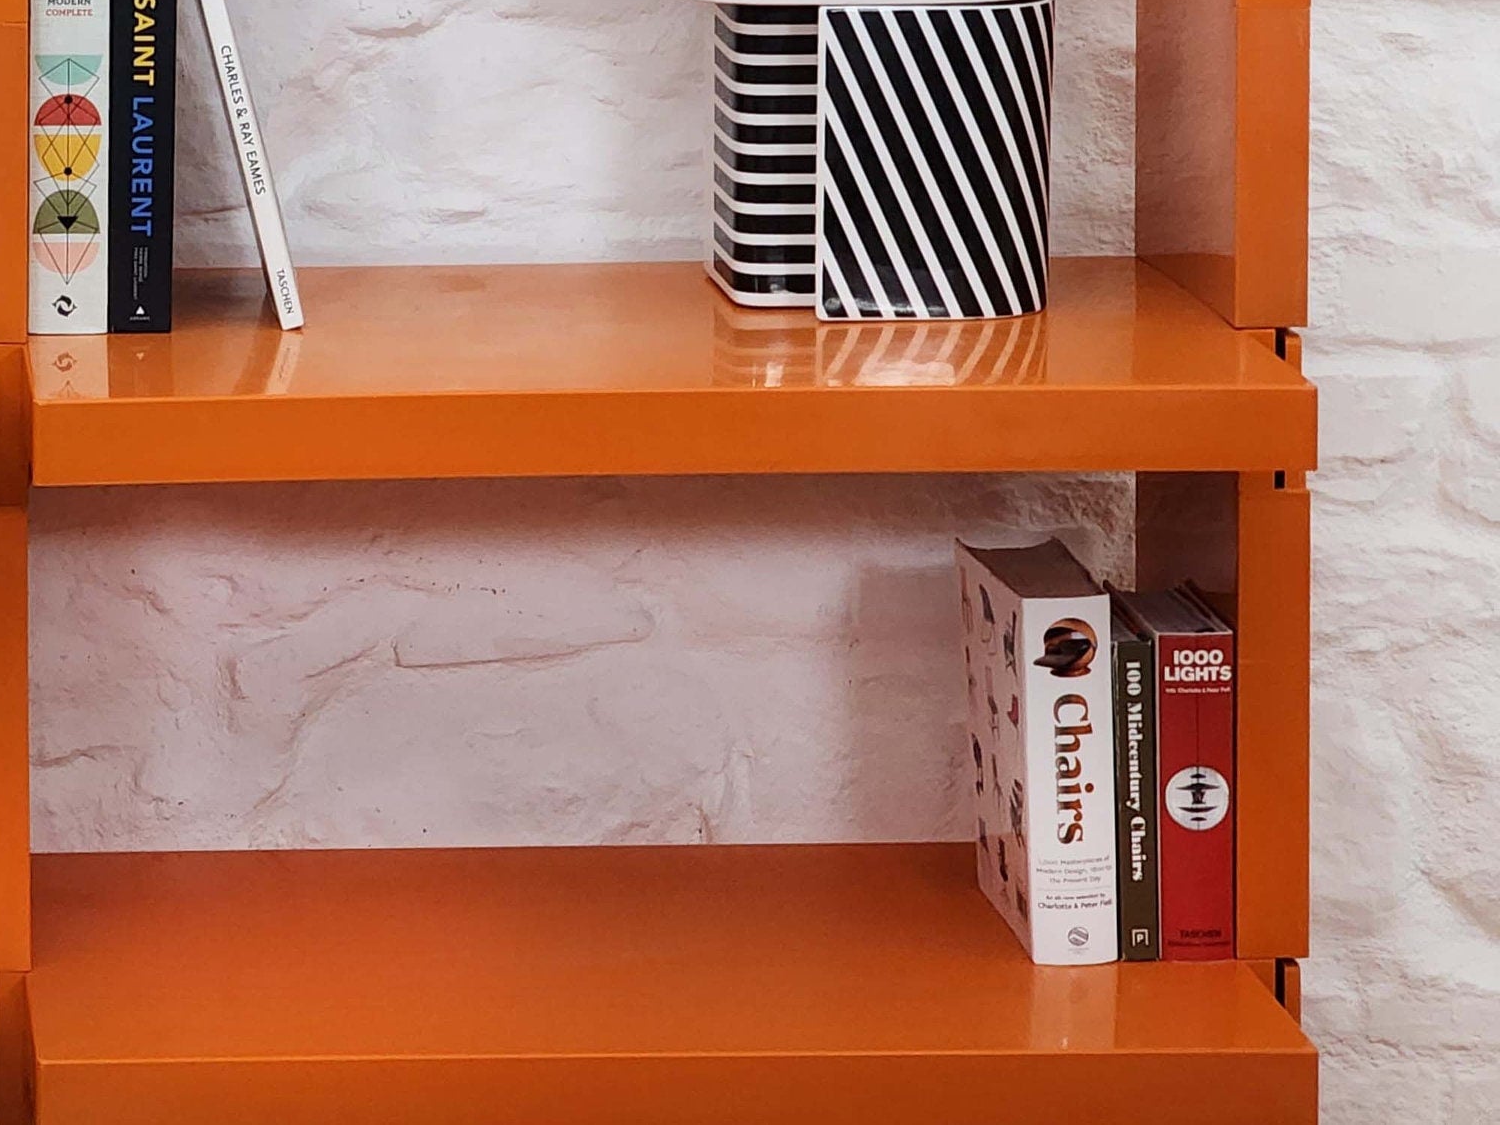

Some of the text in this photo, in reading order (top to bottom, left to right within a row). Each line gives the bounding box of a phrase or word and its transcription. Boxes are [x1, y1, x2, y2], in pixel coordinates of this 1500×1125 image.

[131, 96, 154, 237] LAURENT
[221, 45, 266, 195] CHARLES & RAY EAMES
[277, 269, 294, 314] TASCHEN
[1164, 666, 1232, 682] LIGHTS
[1173, 649, 1224, 665] 1000
[1053, 694, 1095, 844] Chairs
[1126, 661, 1147, 881] 100 Midcentury Chairs
